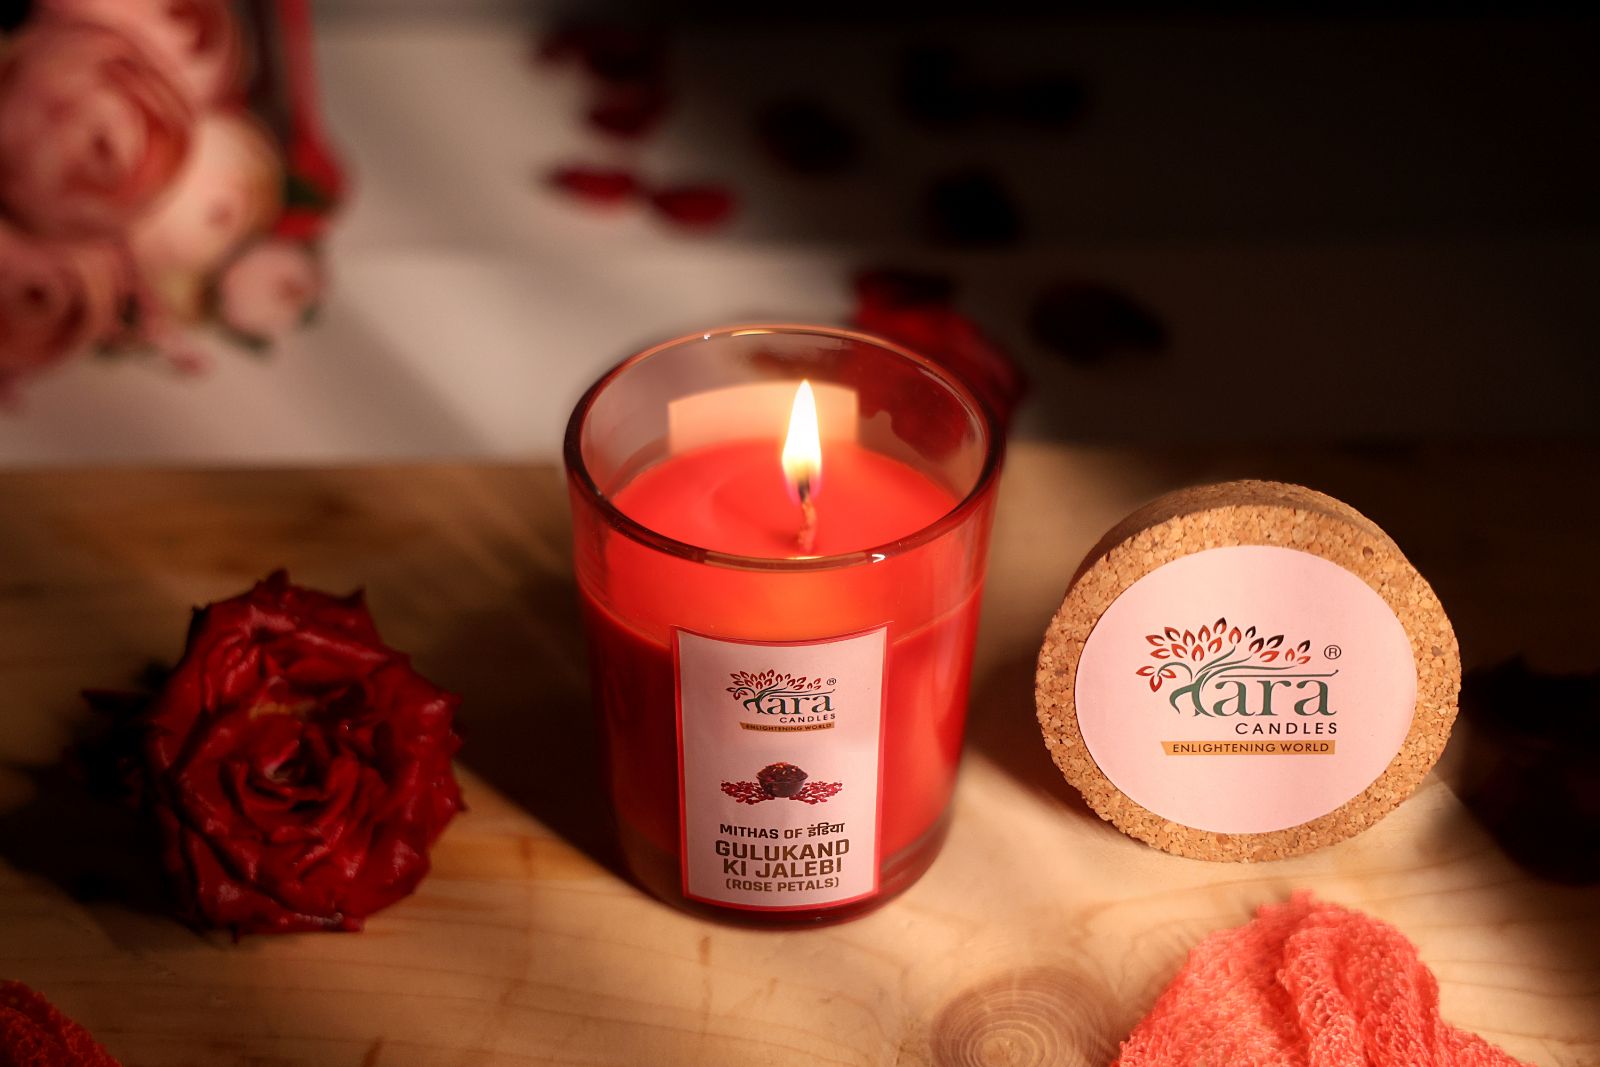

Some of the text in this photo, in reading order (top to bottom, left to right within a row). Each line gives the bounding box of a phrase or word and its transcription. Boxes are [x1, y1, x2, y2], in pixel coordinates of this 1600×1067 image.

[779, 713, 836, 724] CANDLES
[745, 723, 832, 732] ENLIGHTENING WORLD
[1235, 722, 1338, 735] CANDLES
[1172, 742, 1329, 753] ENLIGHTENING WORLD
[720, 822, 846, 839] MITHAS OF इंडिया
[715, 838, 850, 861] GULUKAND
[723, 857, 842, 878] KI JALEBI
[725, 877, 839, 892] (ROSE PETALS)
